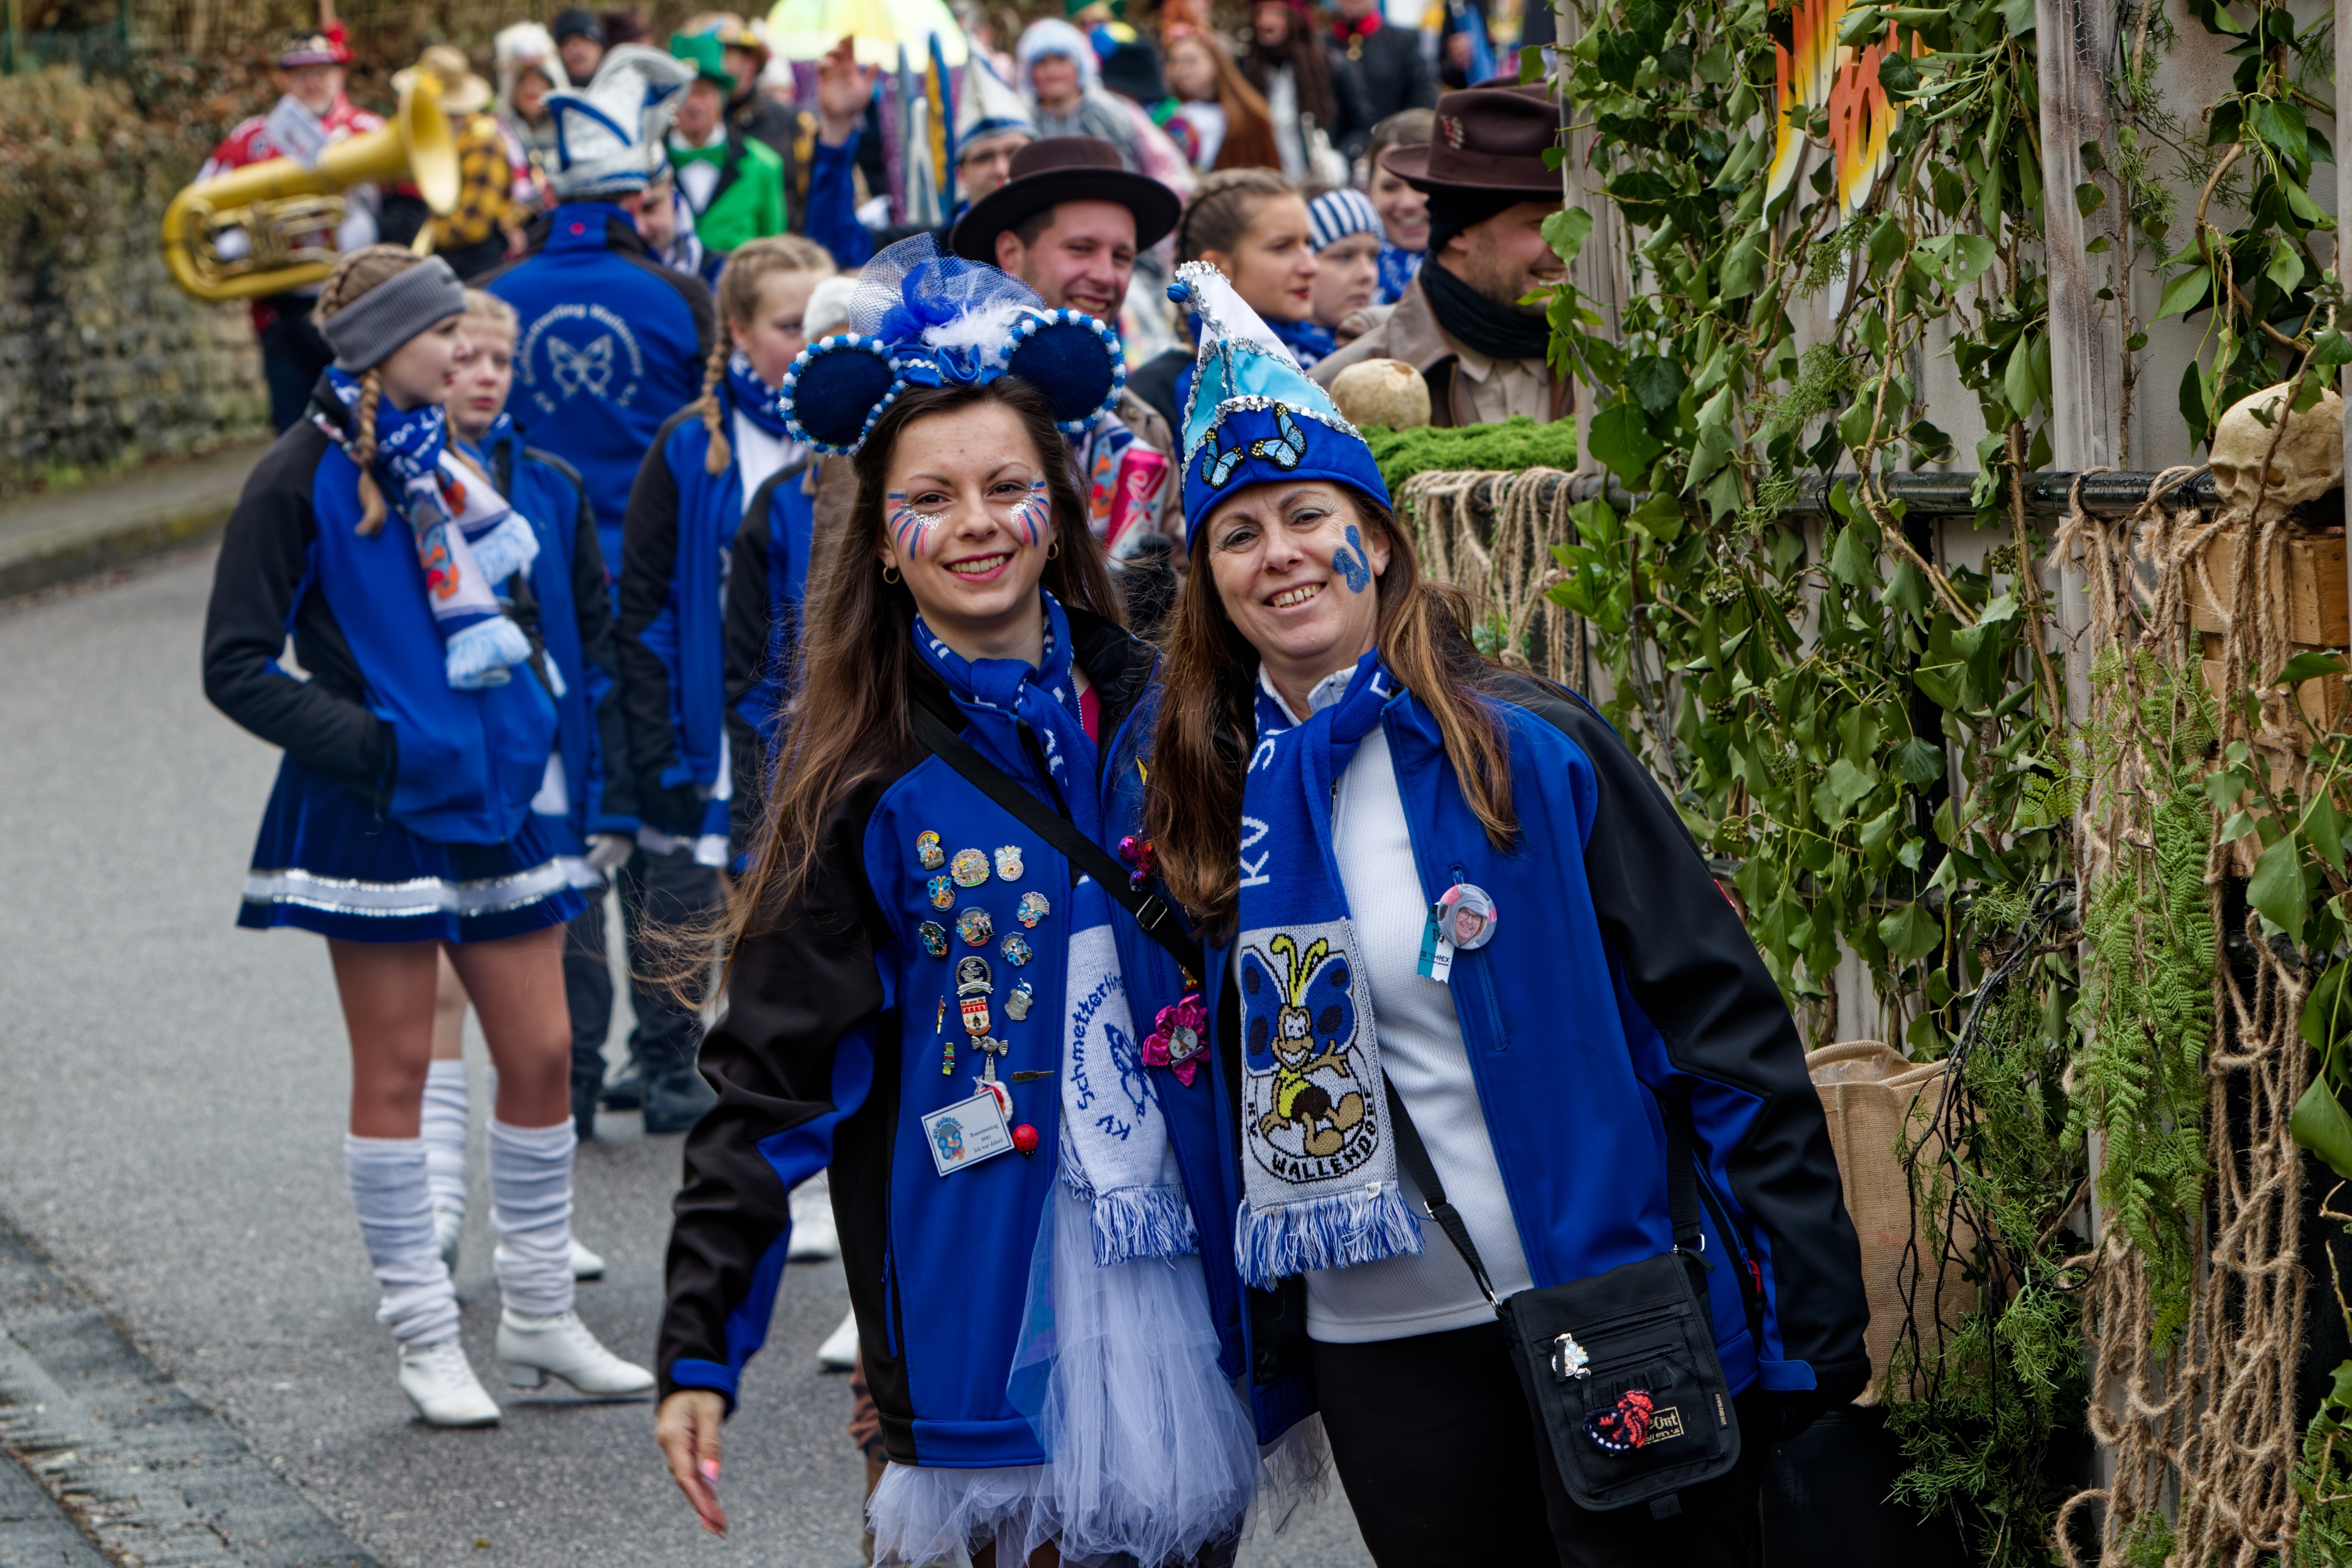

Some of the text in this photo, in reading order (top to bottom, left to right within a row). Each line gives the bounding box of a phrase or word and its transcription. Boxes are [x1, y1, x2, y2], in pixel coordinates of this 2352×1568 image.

[1070, 971, 1124, 1110] Schmetterling
[969, 1124, 999, 1138] Rosenmontag
[1272, 1085, 1376, 1180] WALLENDORF
